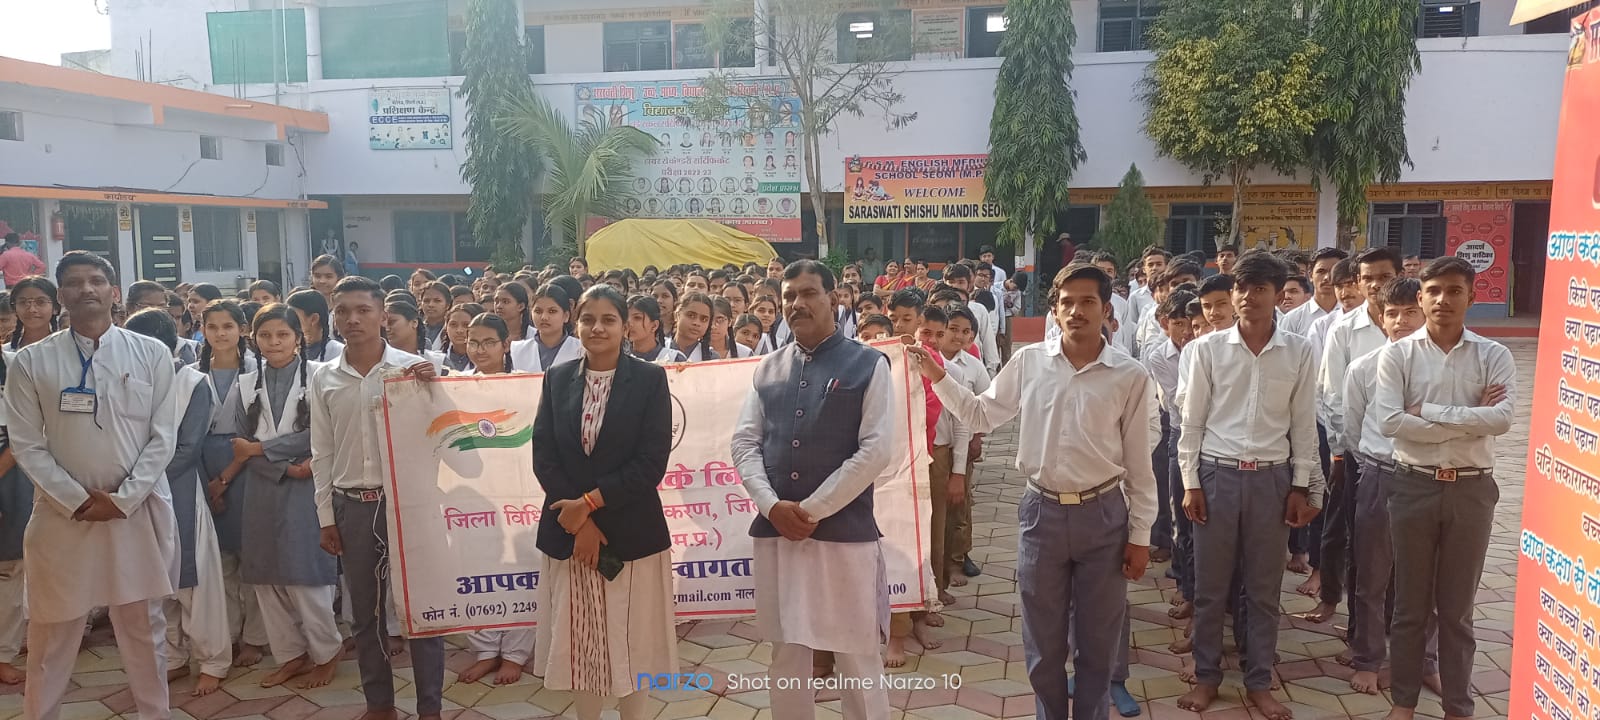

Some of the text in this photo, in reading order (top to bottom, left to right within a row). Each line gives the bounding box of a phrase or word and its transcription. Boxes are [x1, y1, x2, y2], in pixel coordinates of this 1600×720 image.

[875, 170, 918, 180] SCHOOL
[922, 169, 956, 179] SEONI
[904, 187, 967, 199] WELCOME
[1083, 192, 1114, 200] PRACTI
[849, 203, 1008, 219] SARASWATI SHISHU MANDIR SEON
[1551, 233, 1576, 258] आप
[1569, 279, 1588, 305] किसे
[1566, 320, 1581, 339] क्या
[1563, 348, 1578, 374] क्यों
[1559, 379, 1584, 411] कितना
[1556, 413, 1598, 454] कैसे पढ़ाना
[1536, 446, 1552, 478] यदि
[444, 507, 497, 530] जिला
[503, 504, 541, 526] विधि
[663, 502, 719, 522] करण,
[671, 527, 722, 554] म.प्र.)
[1522, 532, 1544, 562] आप
[1546, 546, 1572, 582] कक्षा
[1574, 558, 1585, 592] से
[456, 558, 754, 595] आपक वागत
[422, 582, 907, 621] फोन नं. (07692) 2249 gmail.com नाल 100
[1541, 590, 1595, 647] क्या बच्चों को
[1539, 622, 1553, 647] क्या
[1556, 636, 1577, 667] बच्चों
[1580, 652, 1590, 678] के
[1534, 684, 1549, 711] क्या
[1536, 653, 1550, 679] क्या
[1553, 668, 1574, 702] बच्चों
[1577, 688, 1590, 716] को
